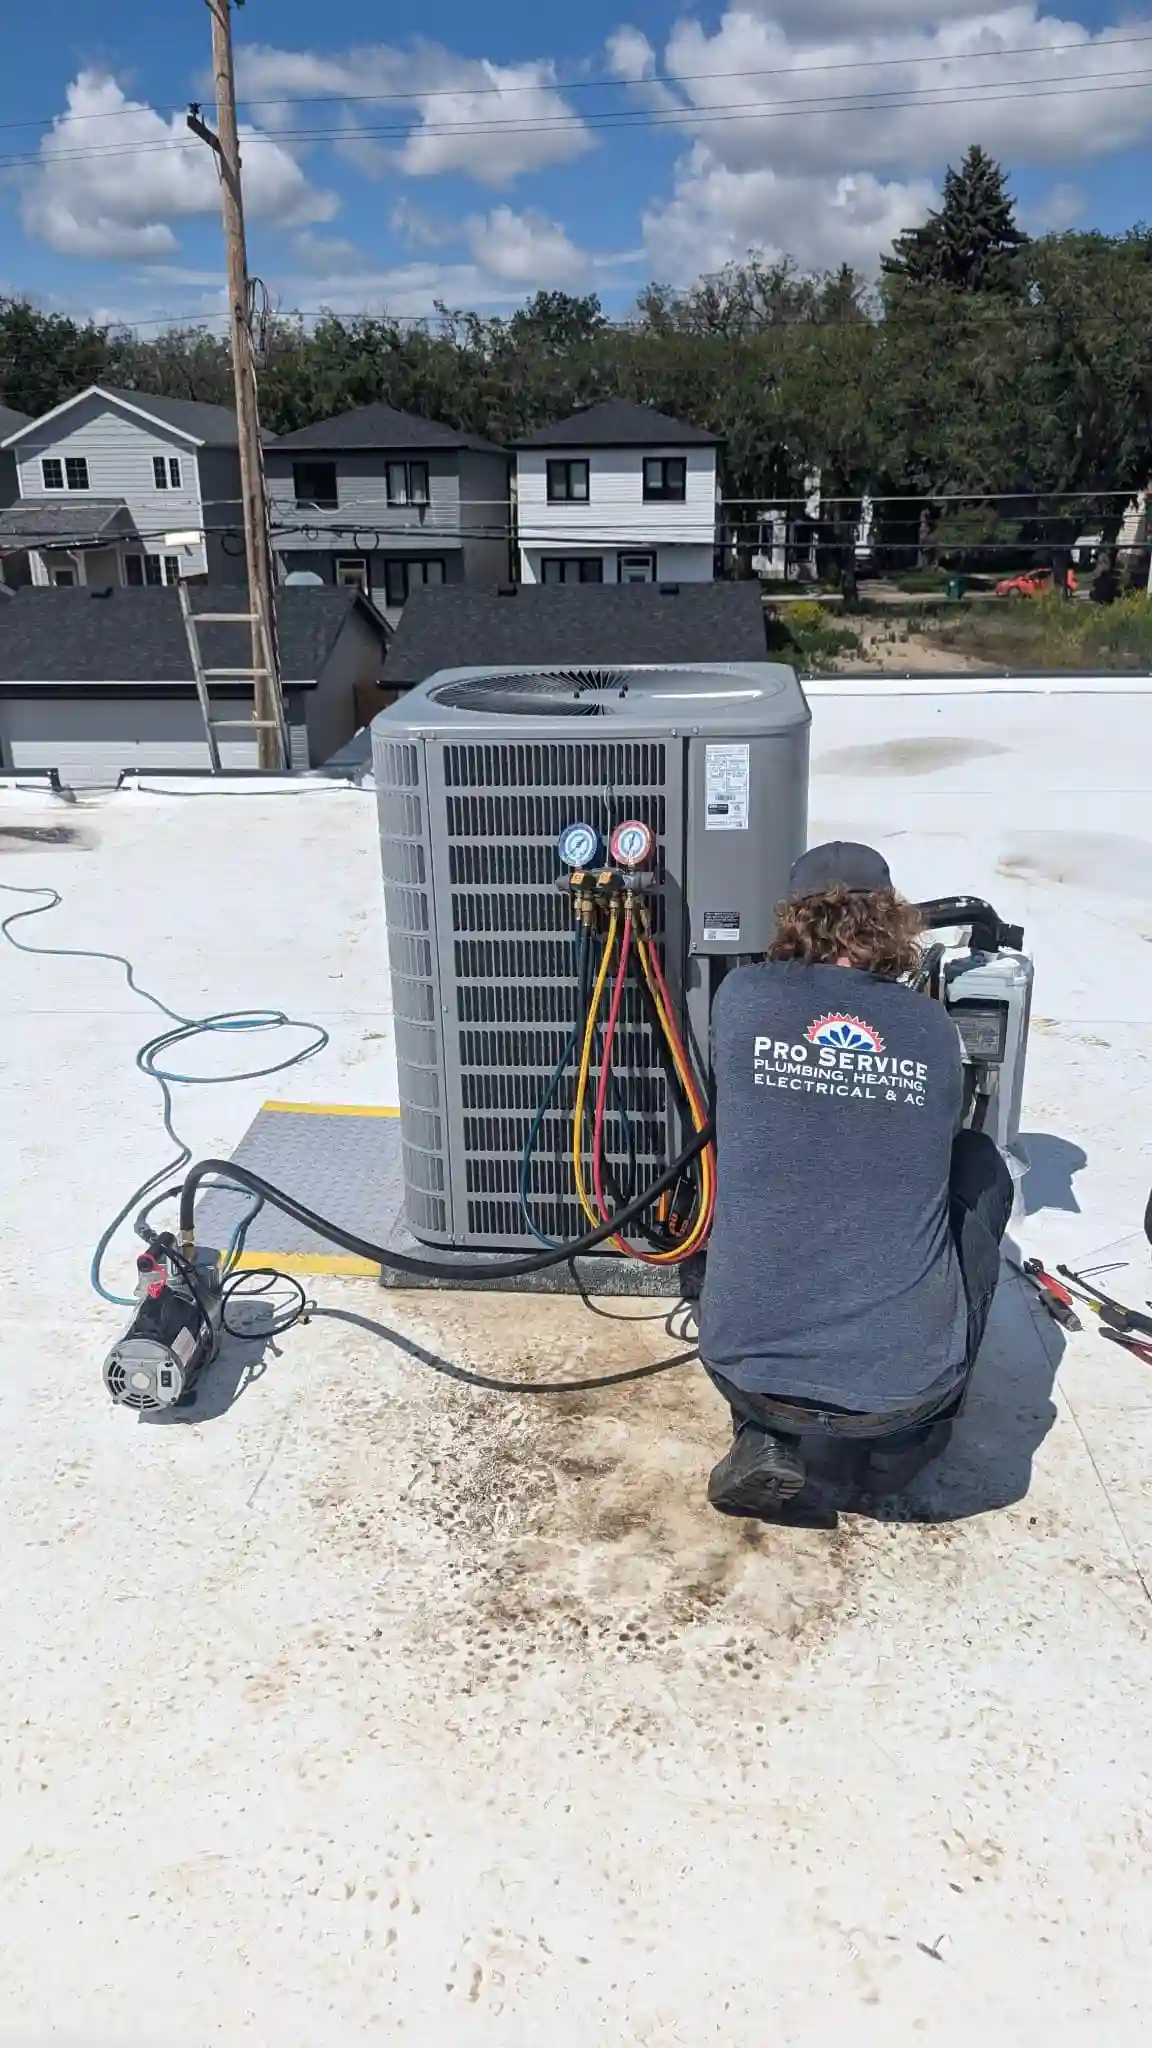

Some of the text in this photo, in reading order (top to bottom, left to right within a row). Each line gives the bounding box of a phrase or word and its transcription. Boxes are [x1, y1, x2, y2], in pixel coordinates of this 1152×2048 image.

[754, 1036, 928, 1081] PRO SERVICE
[753, 1059, 926, 1094] PLUMBING, HEATING,
[754, 1073, 925, 1106] ELECTRICAL & AC
